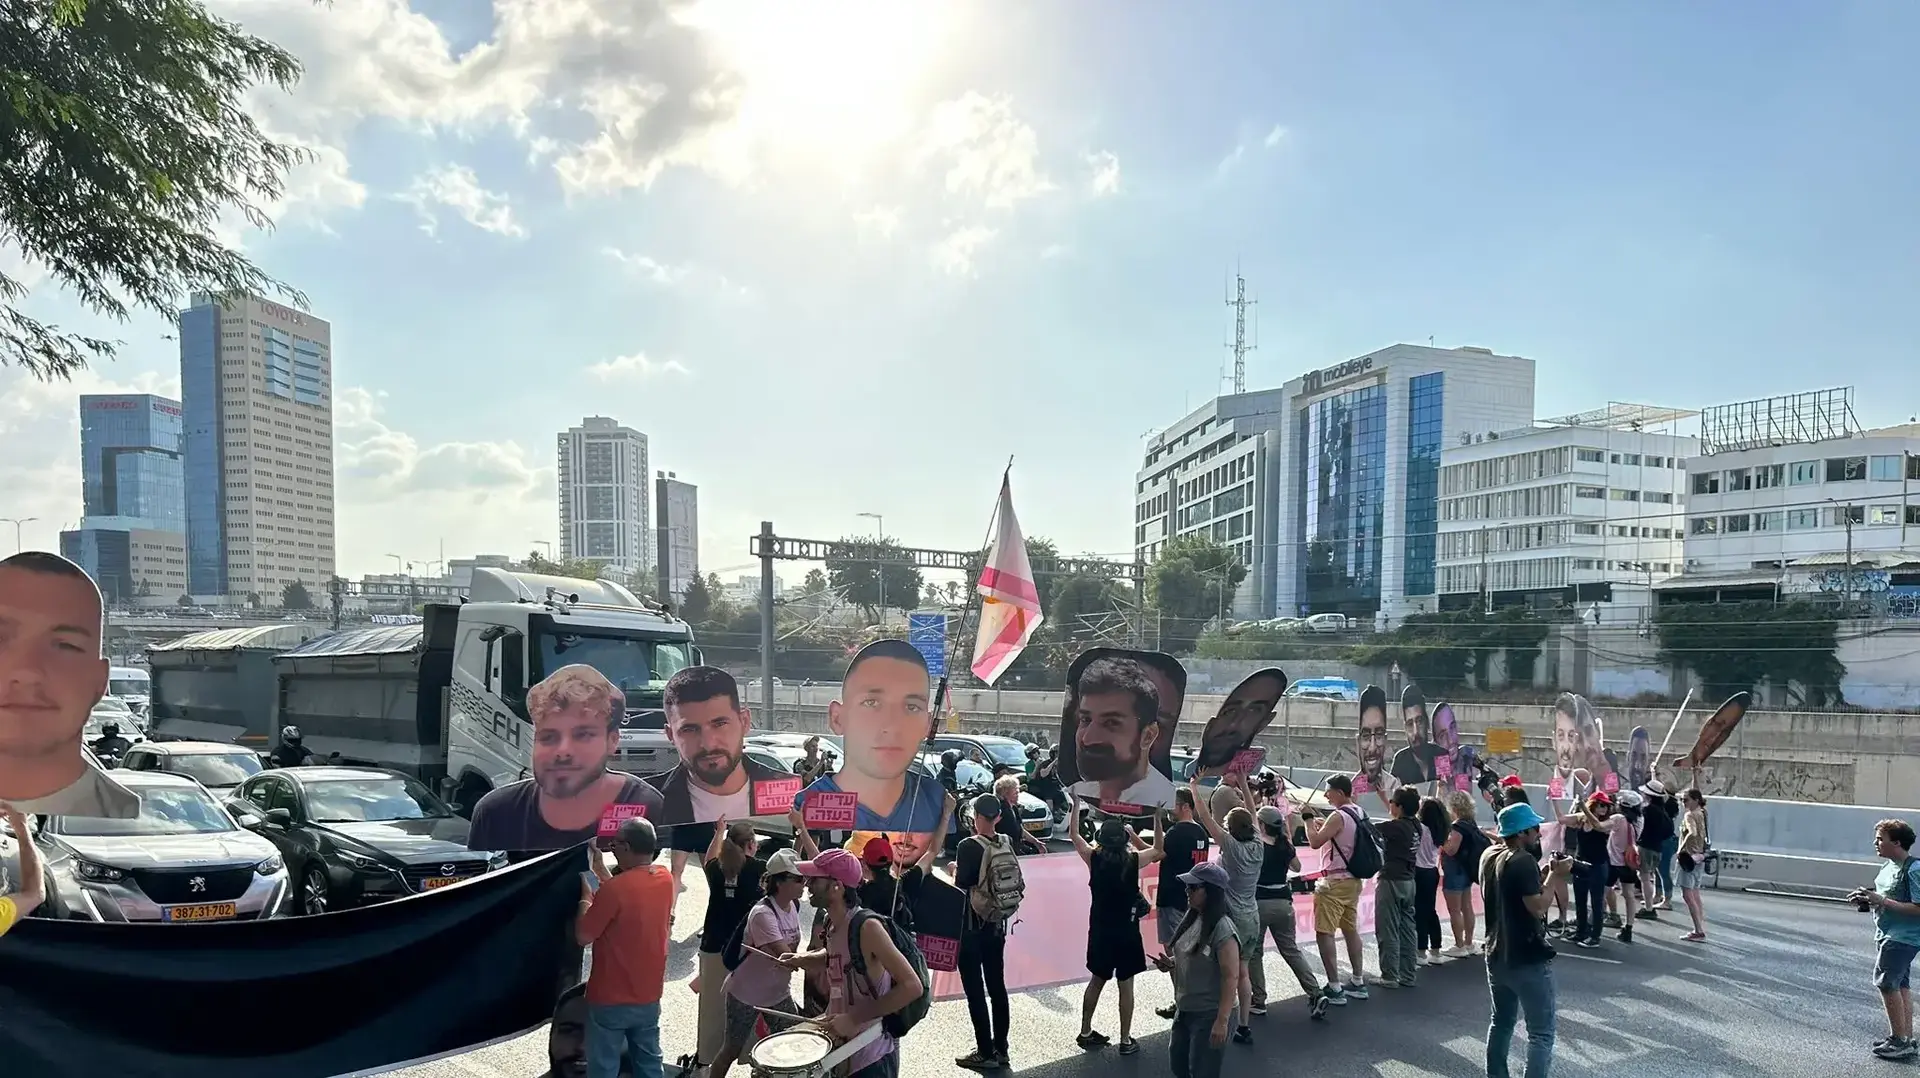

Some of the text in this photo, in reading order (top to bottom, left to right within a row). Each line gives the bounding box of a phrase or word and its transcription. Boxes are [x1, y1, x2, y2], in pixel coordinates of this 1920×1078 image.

[260, 302, 303, 326] TOYOTA
[1323, 357, 1372, 382] mobileye
[493, 711, 520, 747] FH
[820, 794, 854, 806] עדיין
